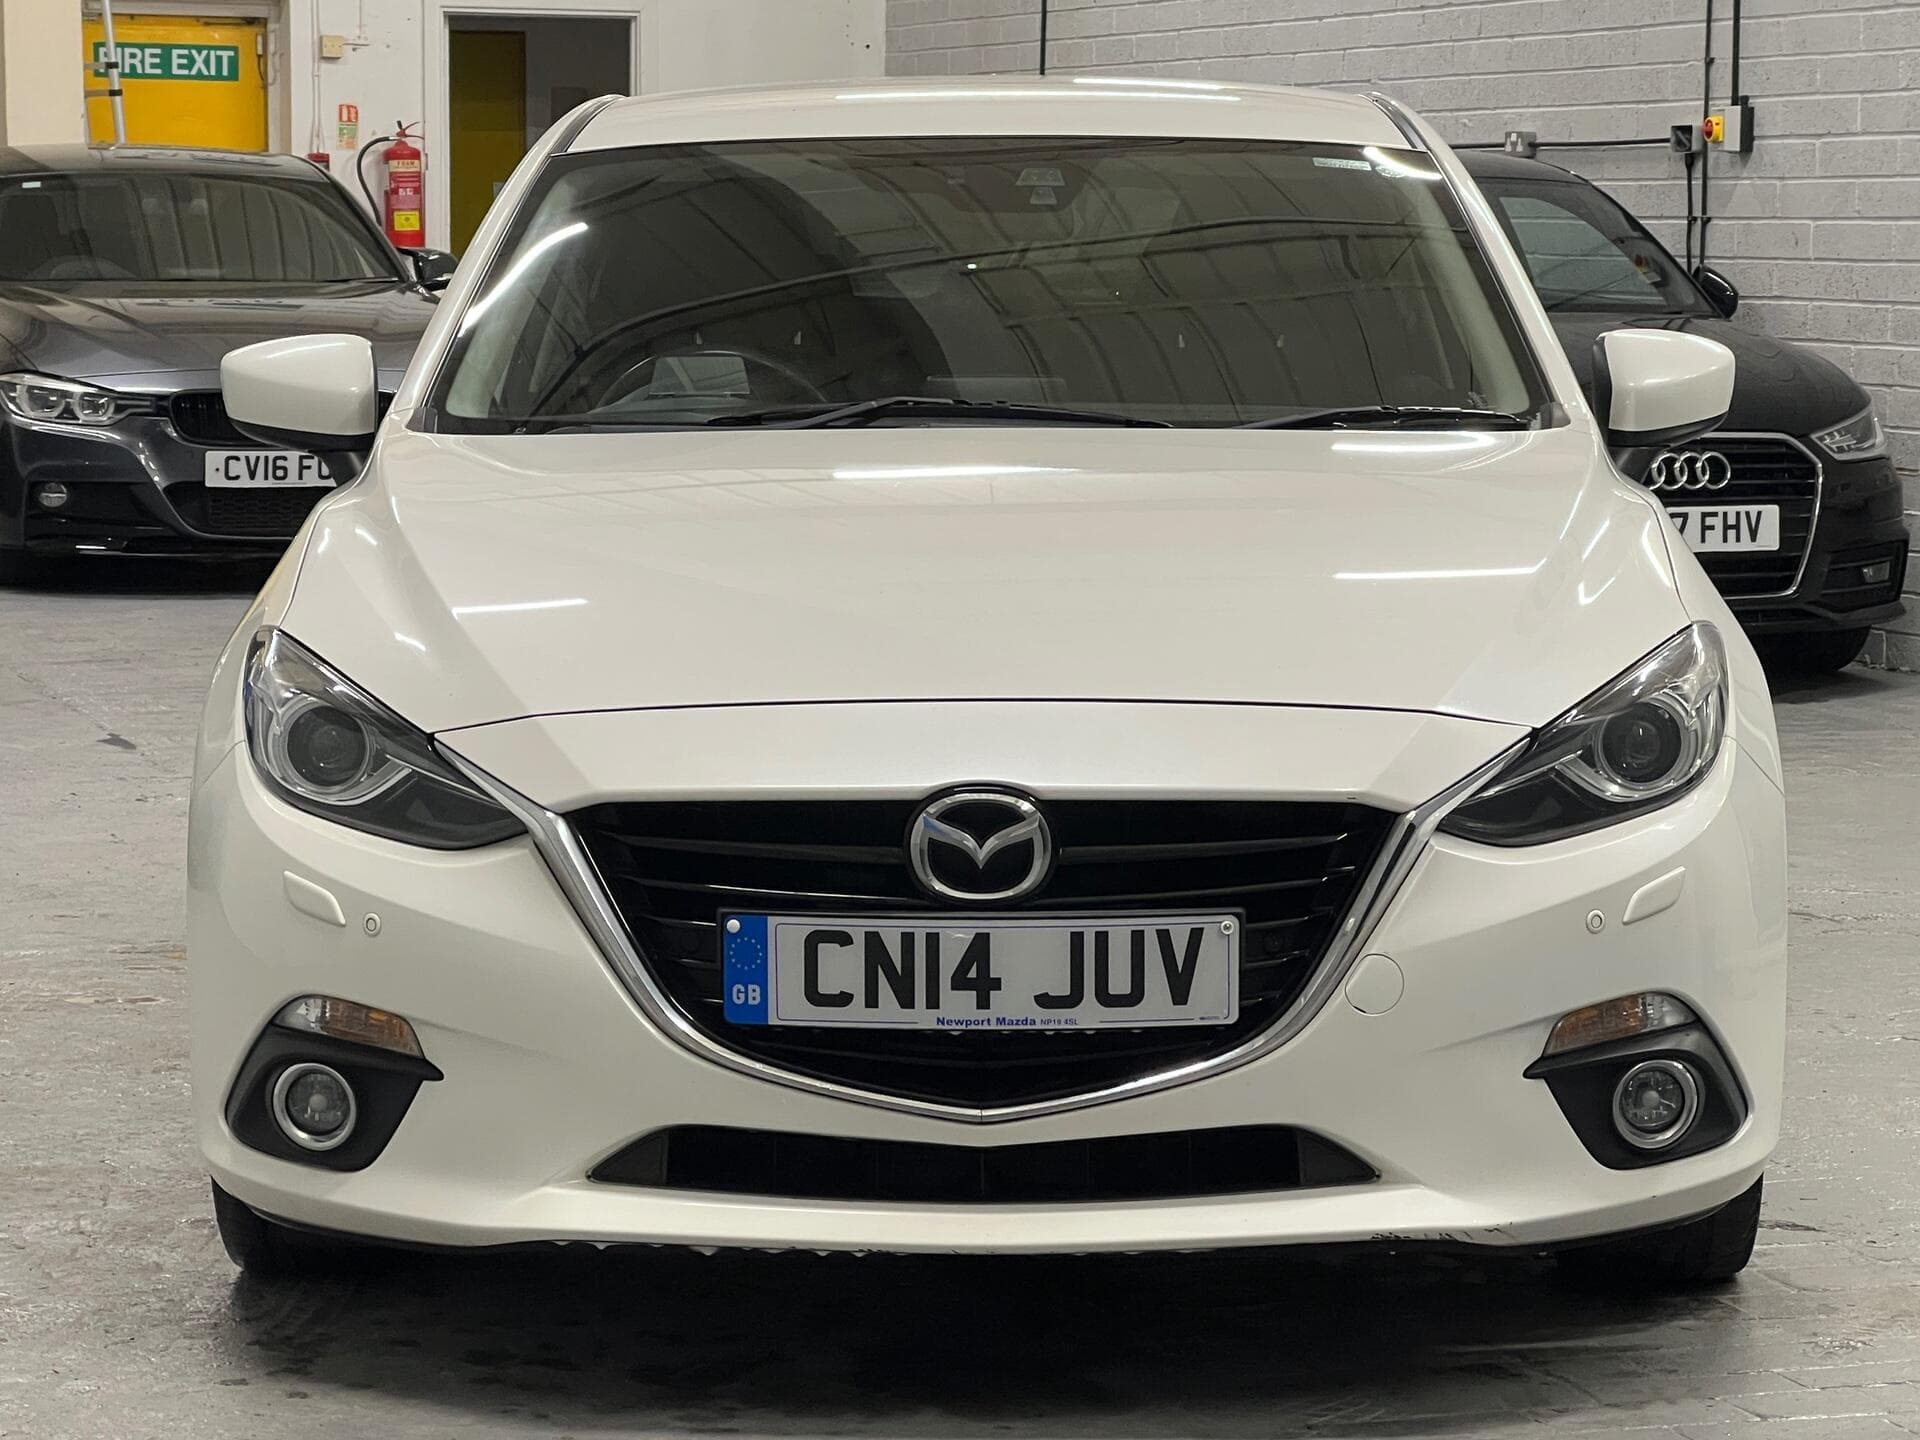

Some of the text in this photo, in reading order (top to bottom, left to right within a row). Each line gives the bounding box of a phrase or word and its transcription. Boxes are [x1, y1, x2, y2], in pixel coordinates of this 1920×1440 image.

[99, 46, 235, 76] FIRE EXIT
[224, 455, 288, 481] CV16
[1700, 510, 1762, 543] FHV
[804, 927, 1204, 1010] CN14 JUV
[732, 984, 761, 1005] GB
[936, 1017, 991, 1028] Newport
[996, 1016, 1036, 1026] Mazda
